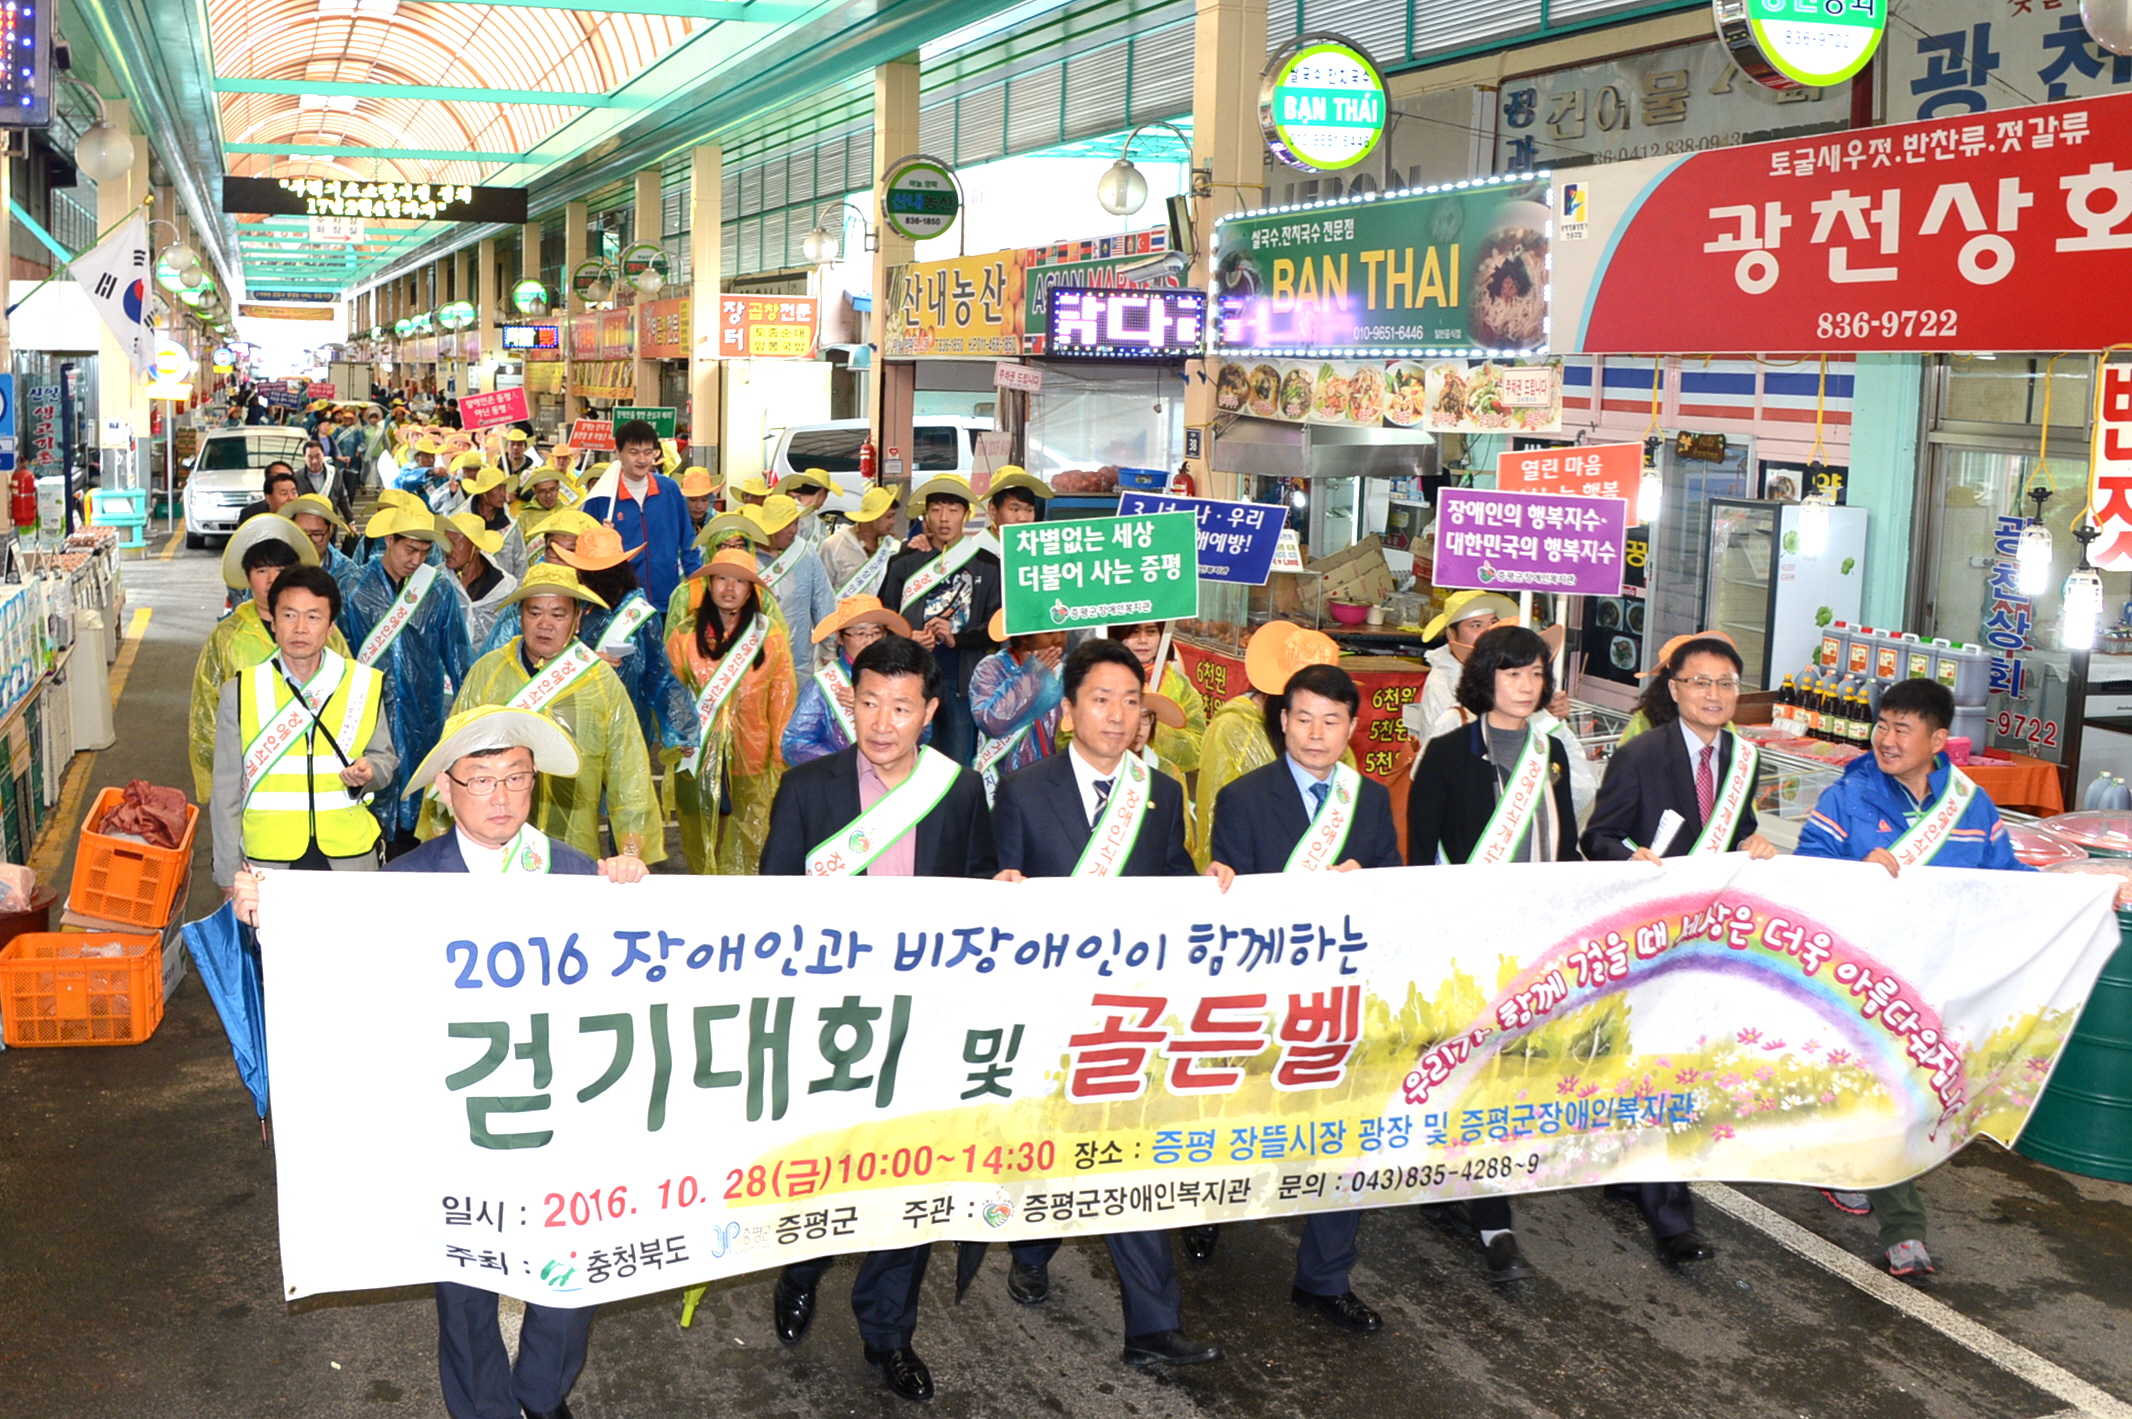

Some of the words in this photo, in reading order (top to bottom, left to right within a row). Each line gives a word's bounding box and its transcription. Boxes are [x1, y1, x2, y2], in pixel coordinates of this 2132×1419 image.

[892, 193, 953, 210] 산내농산
[905, 217, 941, 226] 836-1850
[1323, 218, 1355, 241] 전문점
[1273, 253, 1350, 314] BAN
[1359, 244, 1461, 311] THAI
[901, 262, 1006, 328] 산내농산
[748, 302, 812, 321] 곱창전문
[1817, 310, 1958, 338] 836-9722
[1353, 325, 1423, 342] 010-9651-6446
[1018, 373, 1039, 386] 드립니다
[1525, 378, 1547, 396] 드립니다
[1521, 457, 1559, 481] 열린
[1565, 454, 1603, 476] 마음
[1227, 508, 1265, 531] 우리
[1447, 500, 1523, 528] 장애인의
[1016, 527, 1104, 557] 차별없는
[1112, 521, 1155, 549] 세상
[1445, 531, 1538, 560] 대한민국의
[1543, 536, 1618, 566] 행복지수
[1018, 562, 1084, 592] 더불어
[1090, 560, 1134, 586] 사는
[1140, 552, 1182, 582] 증평
[1497, 570, 1577, 586] 증평군장애인복지관
[1070, 600, 1152, 620] 증평군장애인복지관
[1196, 660, 1227, 695] 6천원
[1365, 751, 1401, 776] 5천
[446, 933, 588, 989] 2016
[611, 924, 873, 982] 장애인과
[893, 927, 1166, 977] 비장애인이
[1188, 914, 1368, 977] 함께하는
[1401, 1026, 1494, 1104] 우리가
[1496, 970, 1569, 1033] 함께
[1568, 932, 1631, 987] 걸을
[1636, 920, 1669, 959] 때
[1761, 916, 1835, 977] 더욱
[445, 994, 912, 1150] 걷기대회
[960, 1024, 1026, 1101] 및
[1068, 984, 1362, 1098] 골든벨
[442, 1195, 504, 1233] 일시
[543, 1185, 638, 1229] 2016.
[657, 1175, 708, 1210] 10.
[1073, 1139, 1124, 1171] 장소
[1152, 1127, 1217, 1165] 증평
[1229, 1119, 1347, 1162] 장뜰시장
[1358, 1113, 1413, 1153] 광장
[1424, 1110, 1450, 1148] 및
[1459, 1091, 1695, 1143] 증평군장애인복지관
[444, 1242, 511, 1276] 주최
[587, 1233, 690, 1284] 충청북도
[774, 1204, 859, 1247] 증평군
[902, 1193, 955, 1230] 주관
[1023, 1176, 1252, 1225] 증평군장애인복지관
[1278, 1172, 1326, 1201] 문의
[1350, 1152, 1540, 1194] 043)835-4288~9
